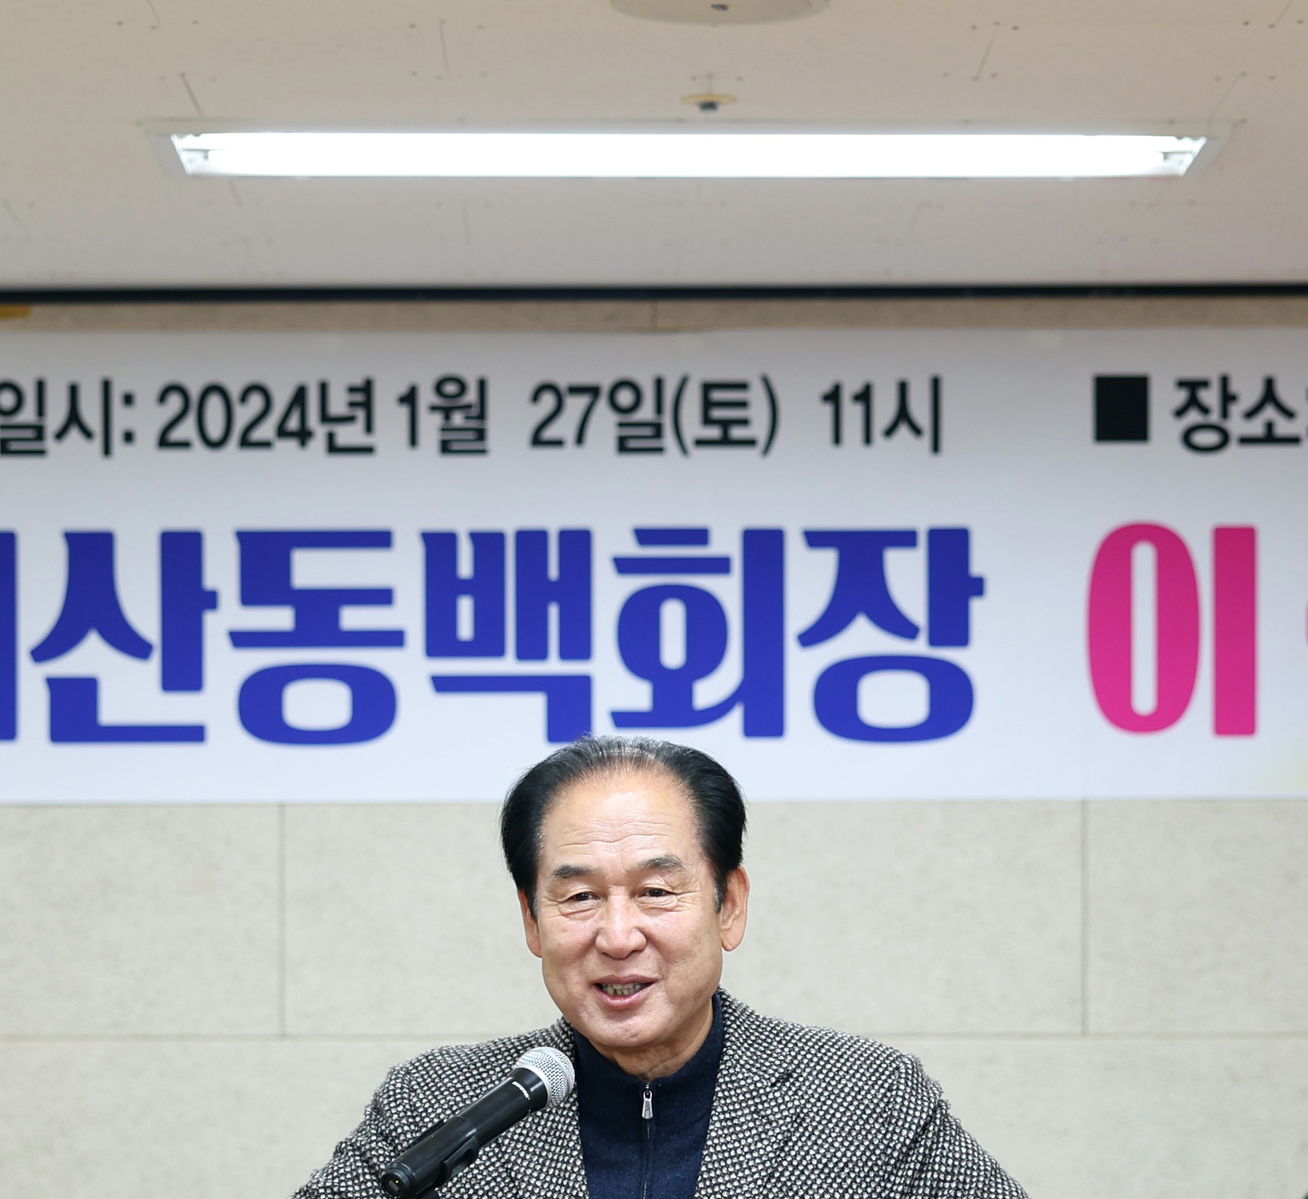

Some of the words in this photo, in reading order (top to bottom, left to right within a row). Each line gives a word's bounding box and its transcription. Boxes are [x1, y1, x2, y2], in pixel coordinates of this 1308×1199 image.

[156, 378, 376, 455] 2024년
[396, 375, 489, 456] 1월
[529, 375, 780, 456] 27일(토)
[820, 376, 942, 454] 11시
